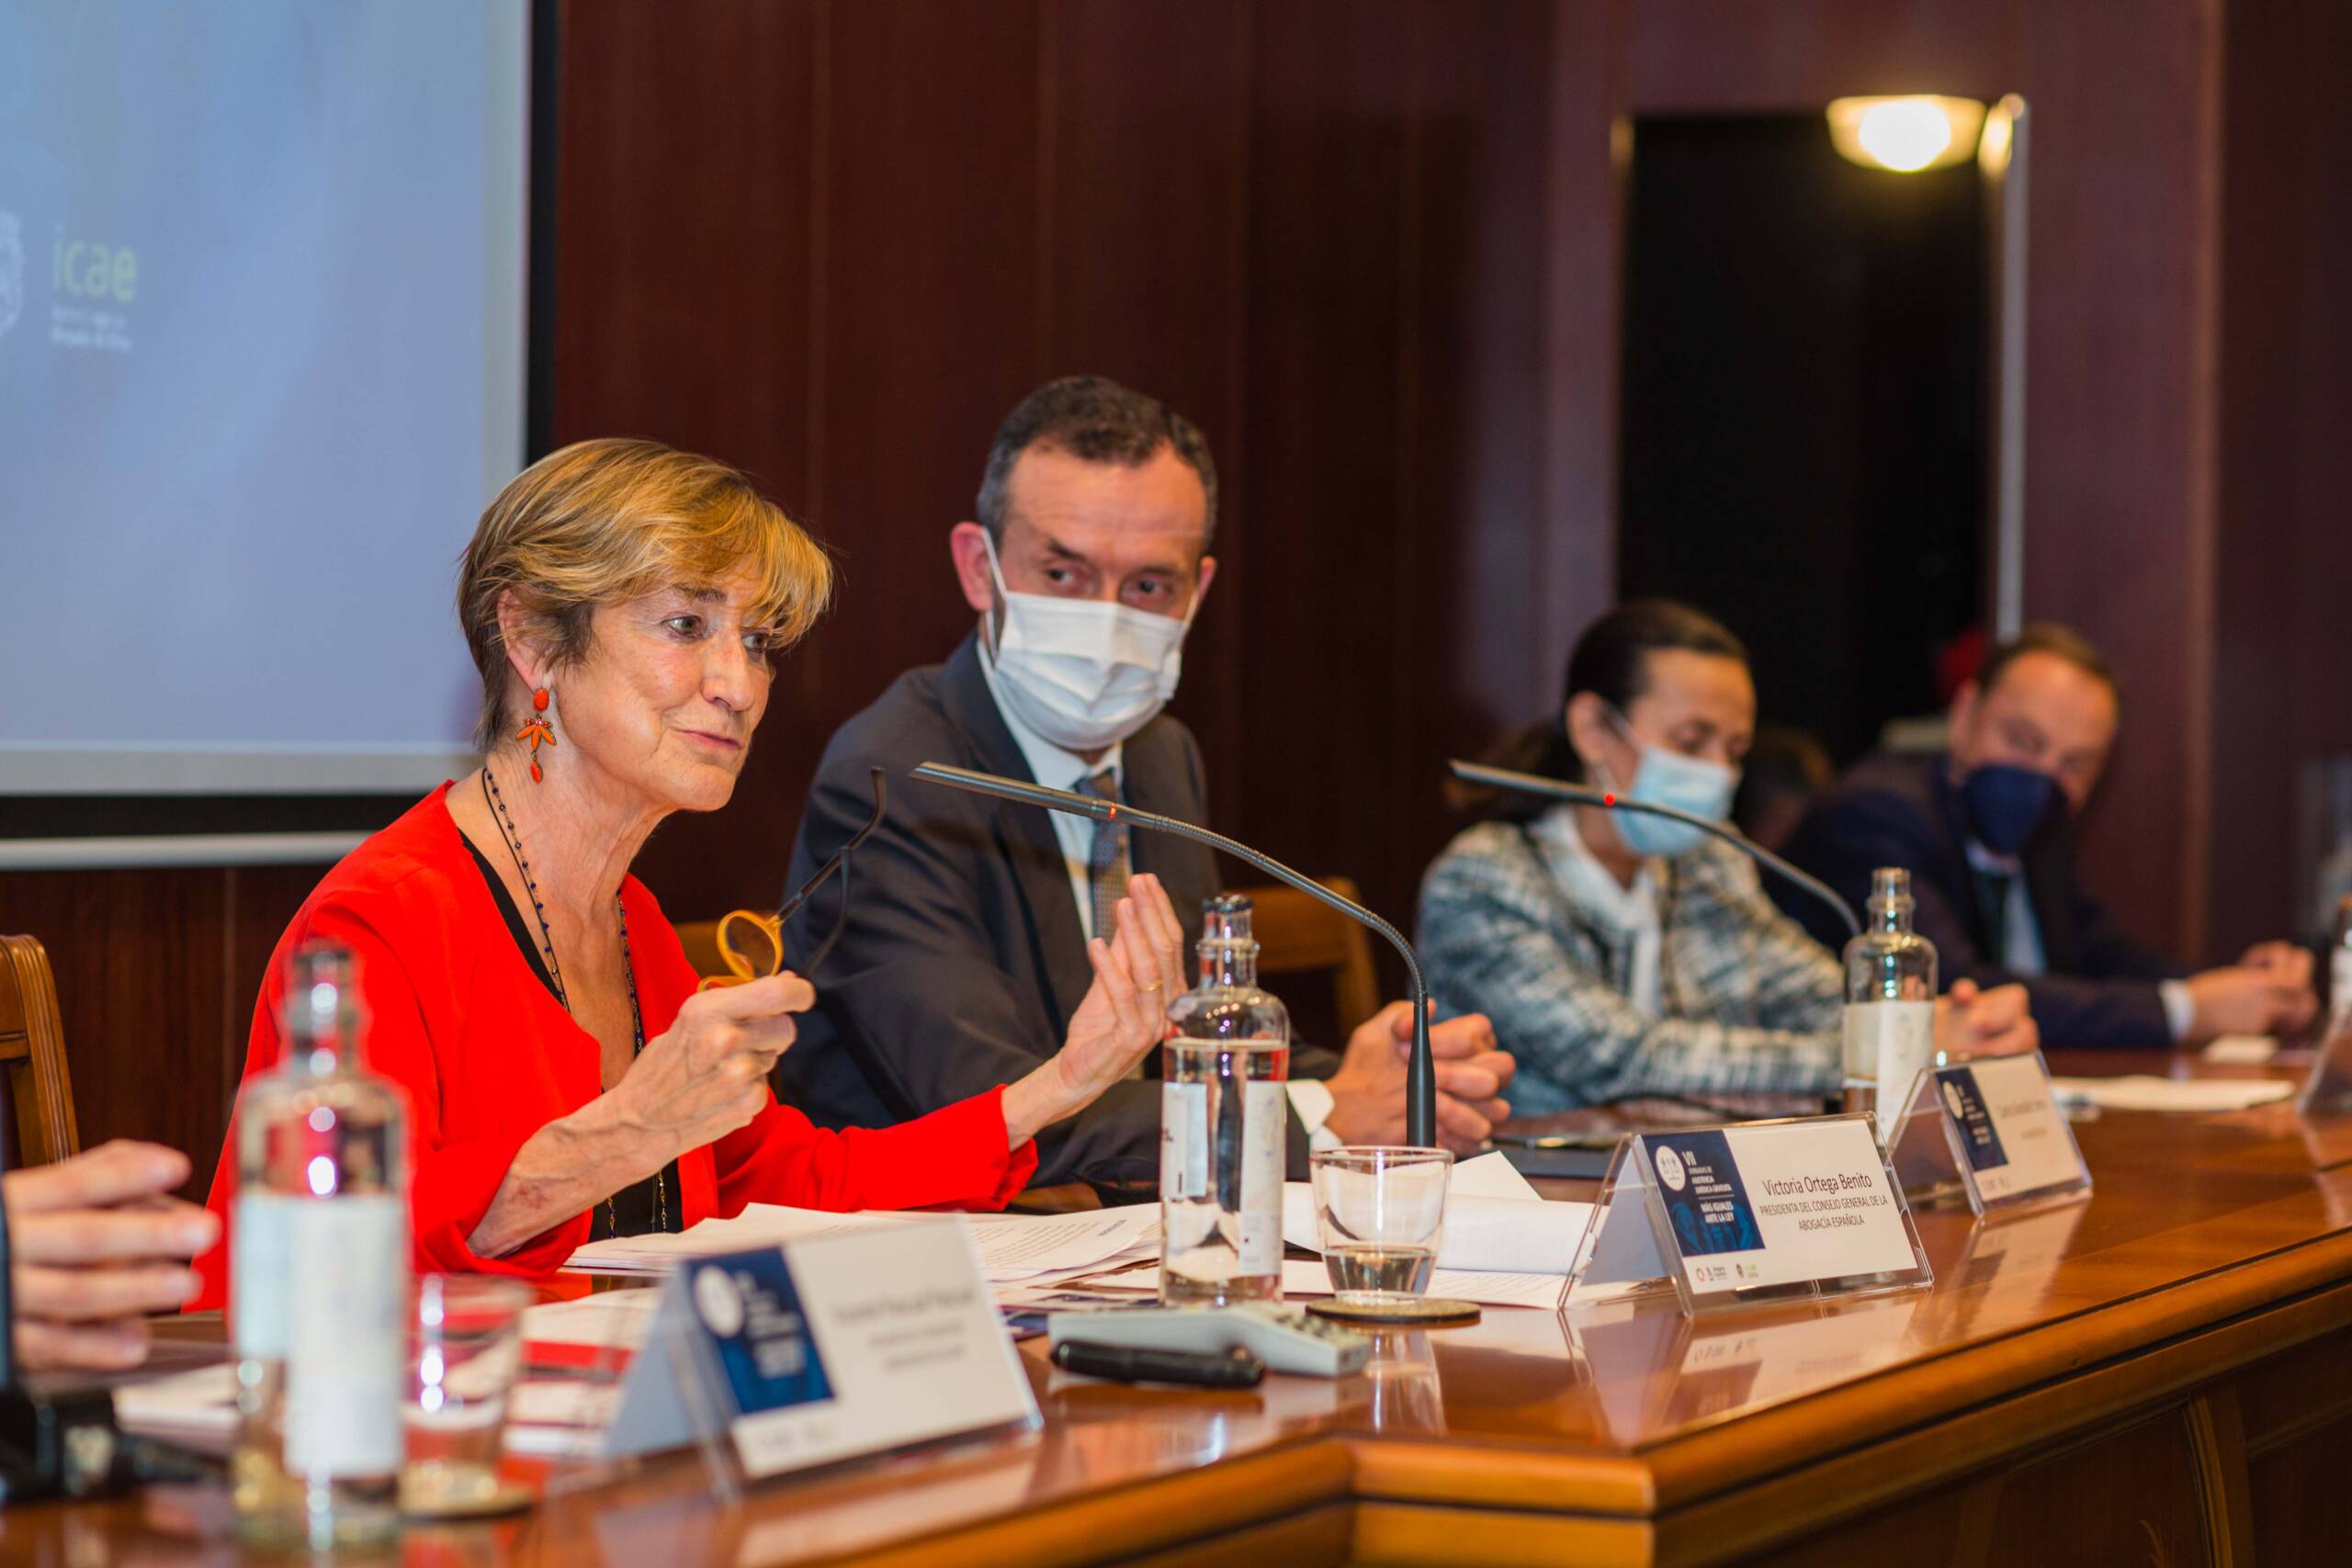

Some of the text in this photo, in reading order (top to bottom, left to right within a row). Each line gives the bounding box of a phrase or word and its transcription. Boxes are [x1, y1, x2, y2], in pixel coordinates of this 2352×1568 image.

[52, 221, 138, 304] icae
[1762, 1172, 1872, 1195] Victoria Ortega Benito
[1759, 1195, 1888, 1215] PRESIDENTA DEL CONSEJO GENERAL DE LA
[1798, 1213, 1864, 1231] ABOGACÍA ESPAÑOLA
